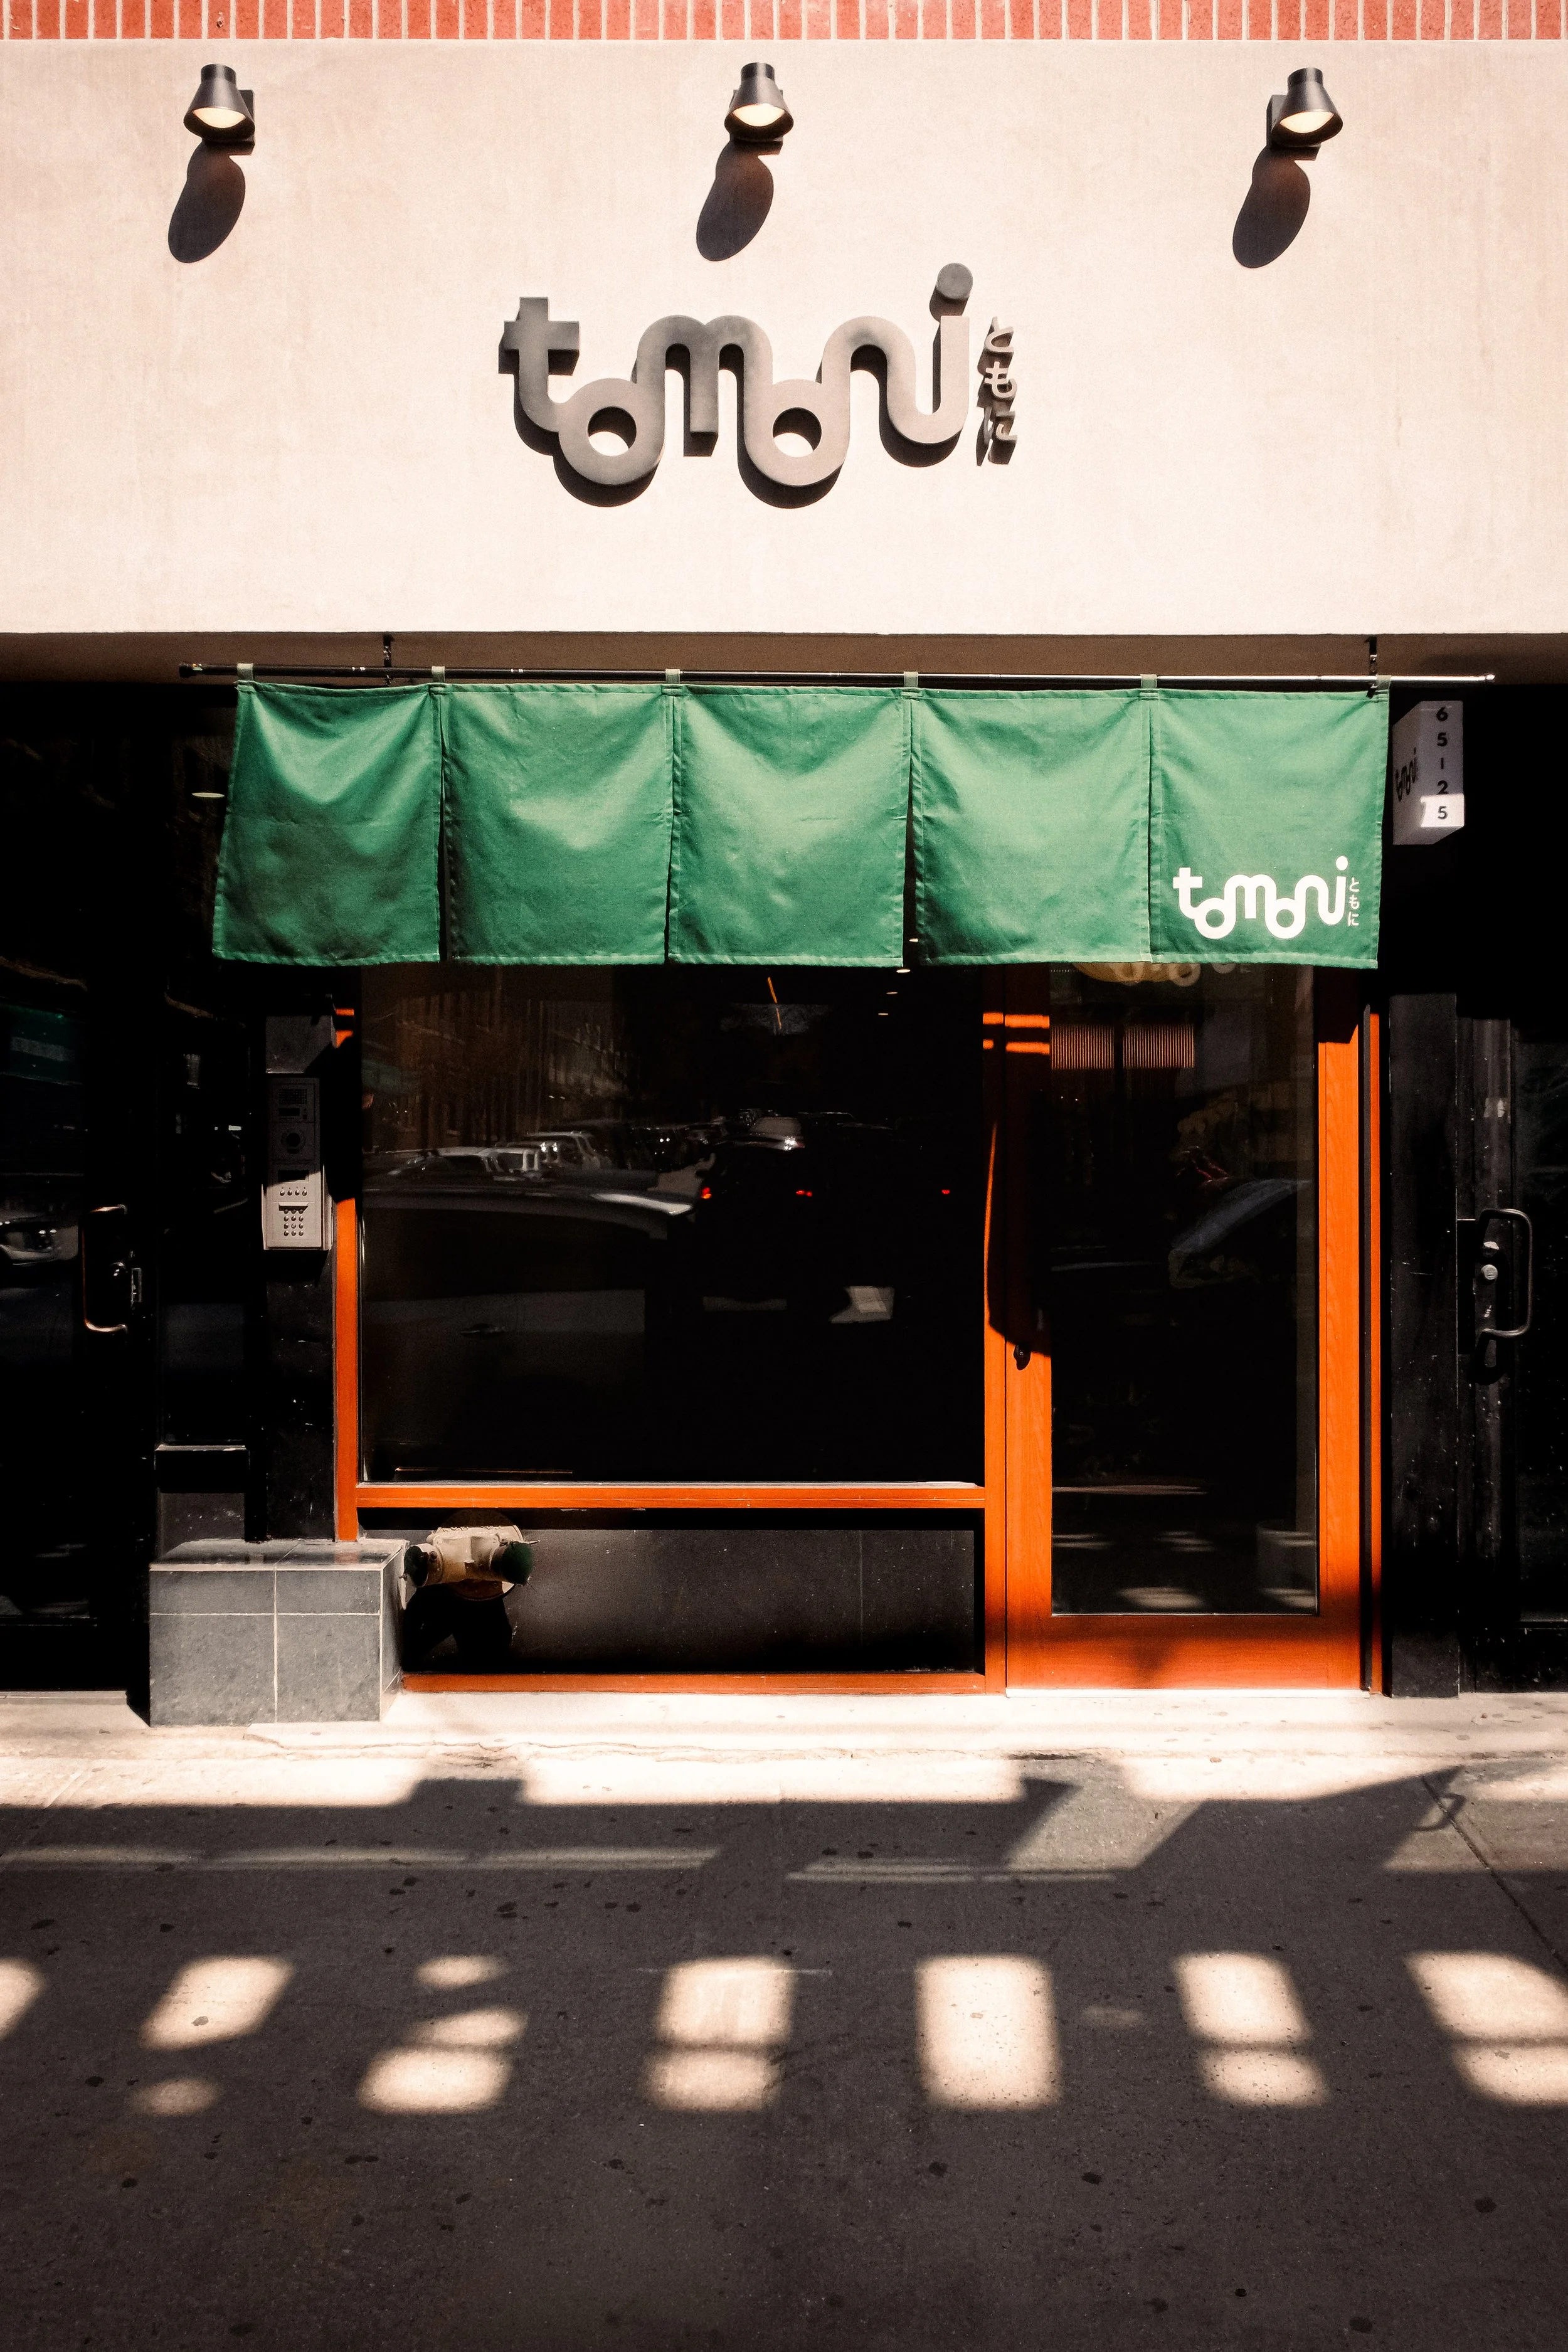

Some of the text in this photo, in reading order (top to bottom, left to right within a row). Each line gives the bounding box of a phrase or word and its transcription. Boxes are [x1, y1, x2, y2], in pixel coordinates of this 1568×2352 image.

[504, 262, 973, 485] tomoni
[1173, 856, 1348, 940] tomoni
[1348, 877, 1360, 926] ともに
